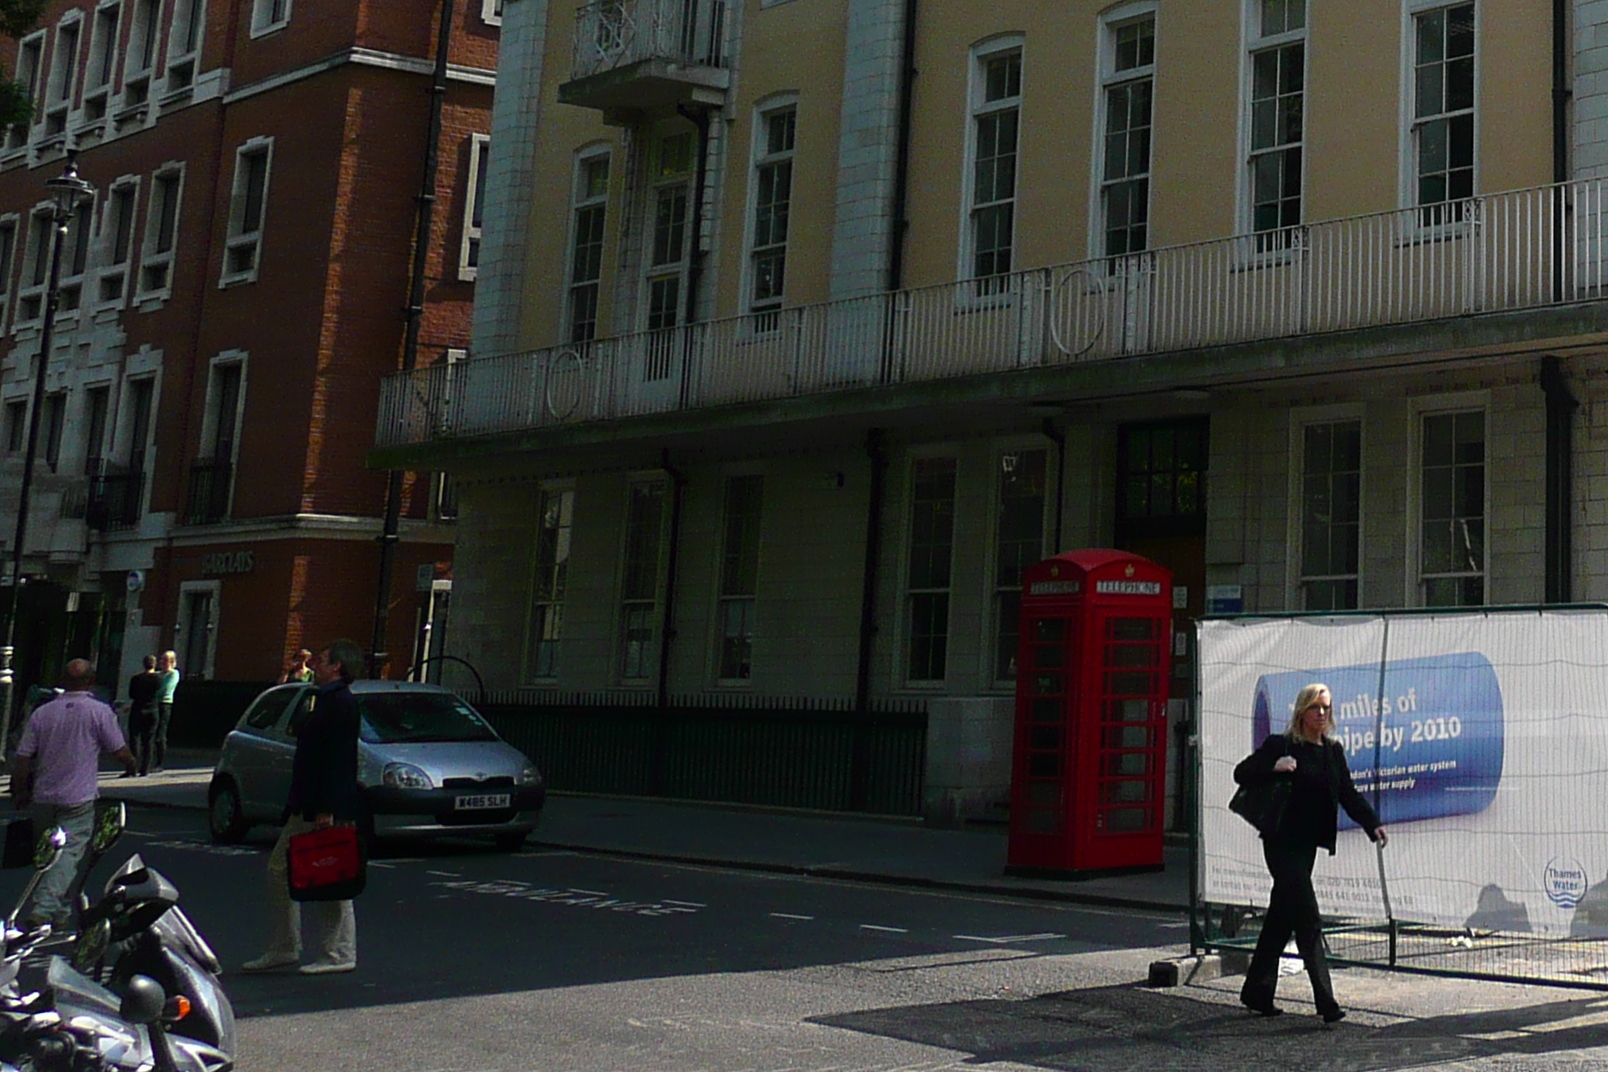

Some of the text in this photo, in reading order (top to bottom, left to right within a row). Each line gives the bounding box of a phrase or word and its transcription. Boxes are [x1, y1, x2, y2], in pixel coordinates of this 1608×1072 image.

[1098, 581, 1159, 594] TELEPHONE
[1340, 688, 1417, 720] miles of
[1380, 722, 1404, 752] by
[1411, 716, 1462, 742] 2010
[1430, 759, 1457, 773] system
[1549, 868, 1581, 879] Thames
[1553, 879, 1579, 891] Water
